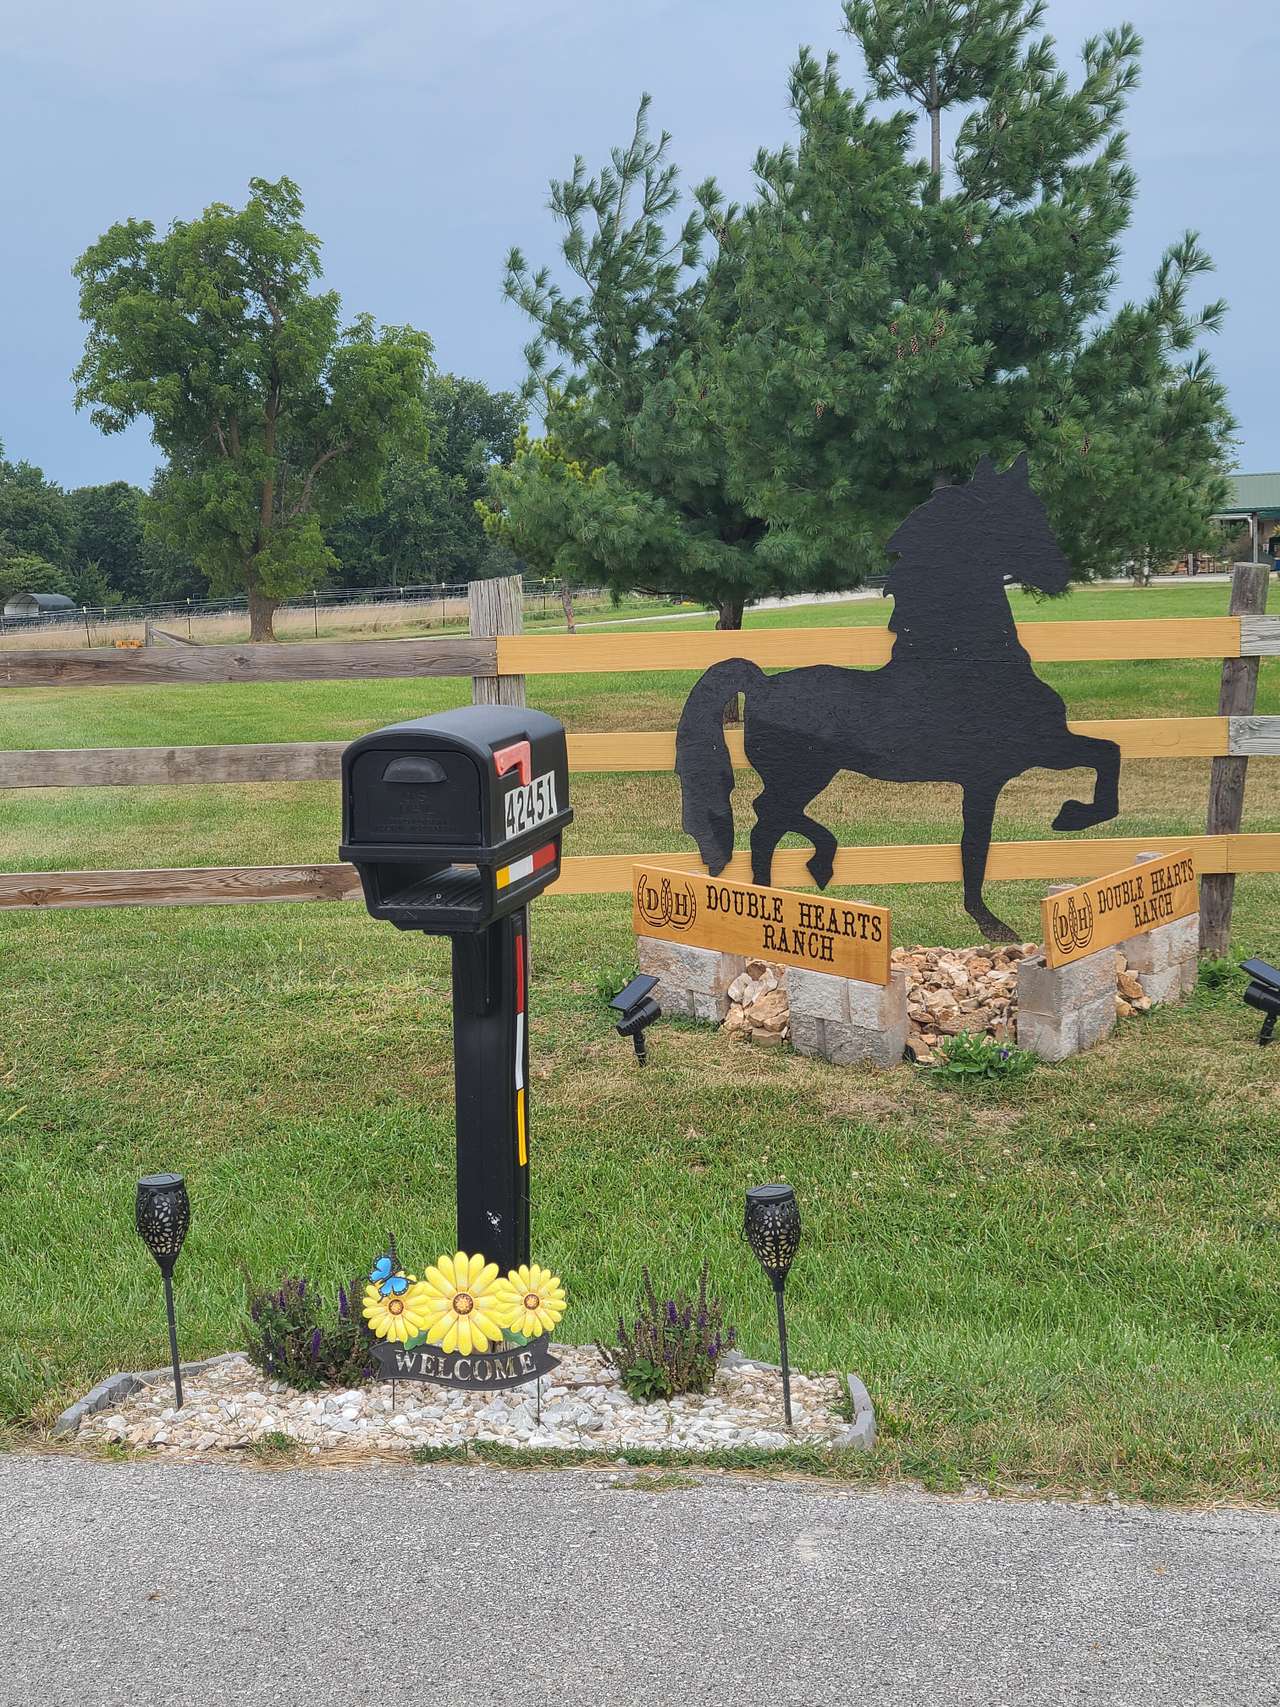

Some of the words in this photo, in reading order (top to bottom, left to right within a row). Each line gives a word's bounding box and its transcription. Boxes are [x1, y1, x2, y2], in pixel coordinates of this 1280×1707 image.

[506, 774, 554, 835] 42451
[1097, 876, 1145, 914] DOUBLE
[1150, 858, 1195, 895] HEARTS
[706, 884, 784, 923] DOUBLE
[798, 902, 882, 942] HEARTS
[1132, 892, 1174, 929] RANCH
[762, 924, 835, 962] RANCH
[395, 1351, 537, 1382] WELCOME
